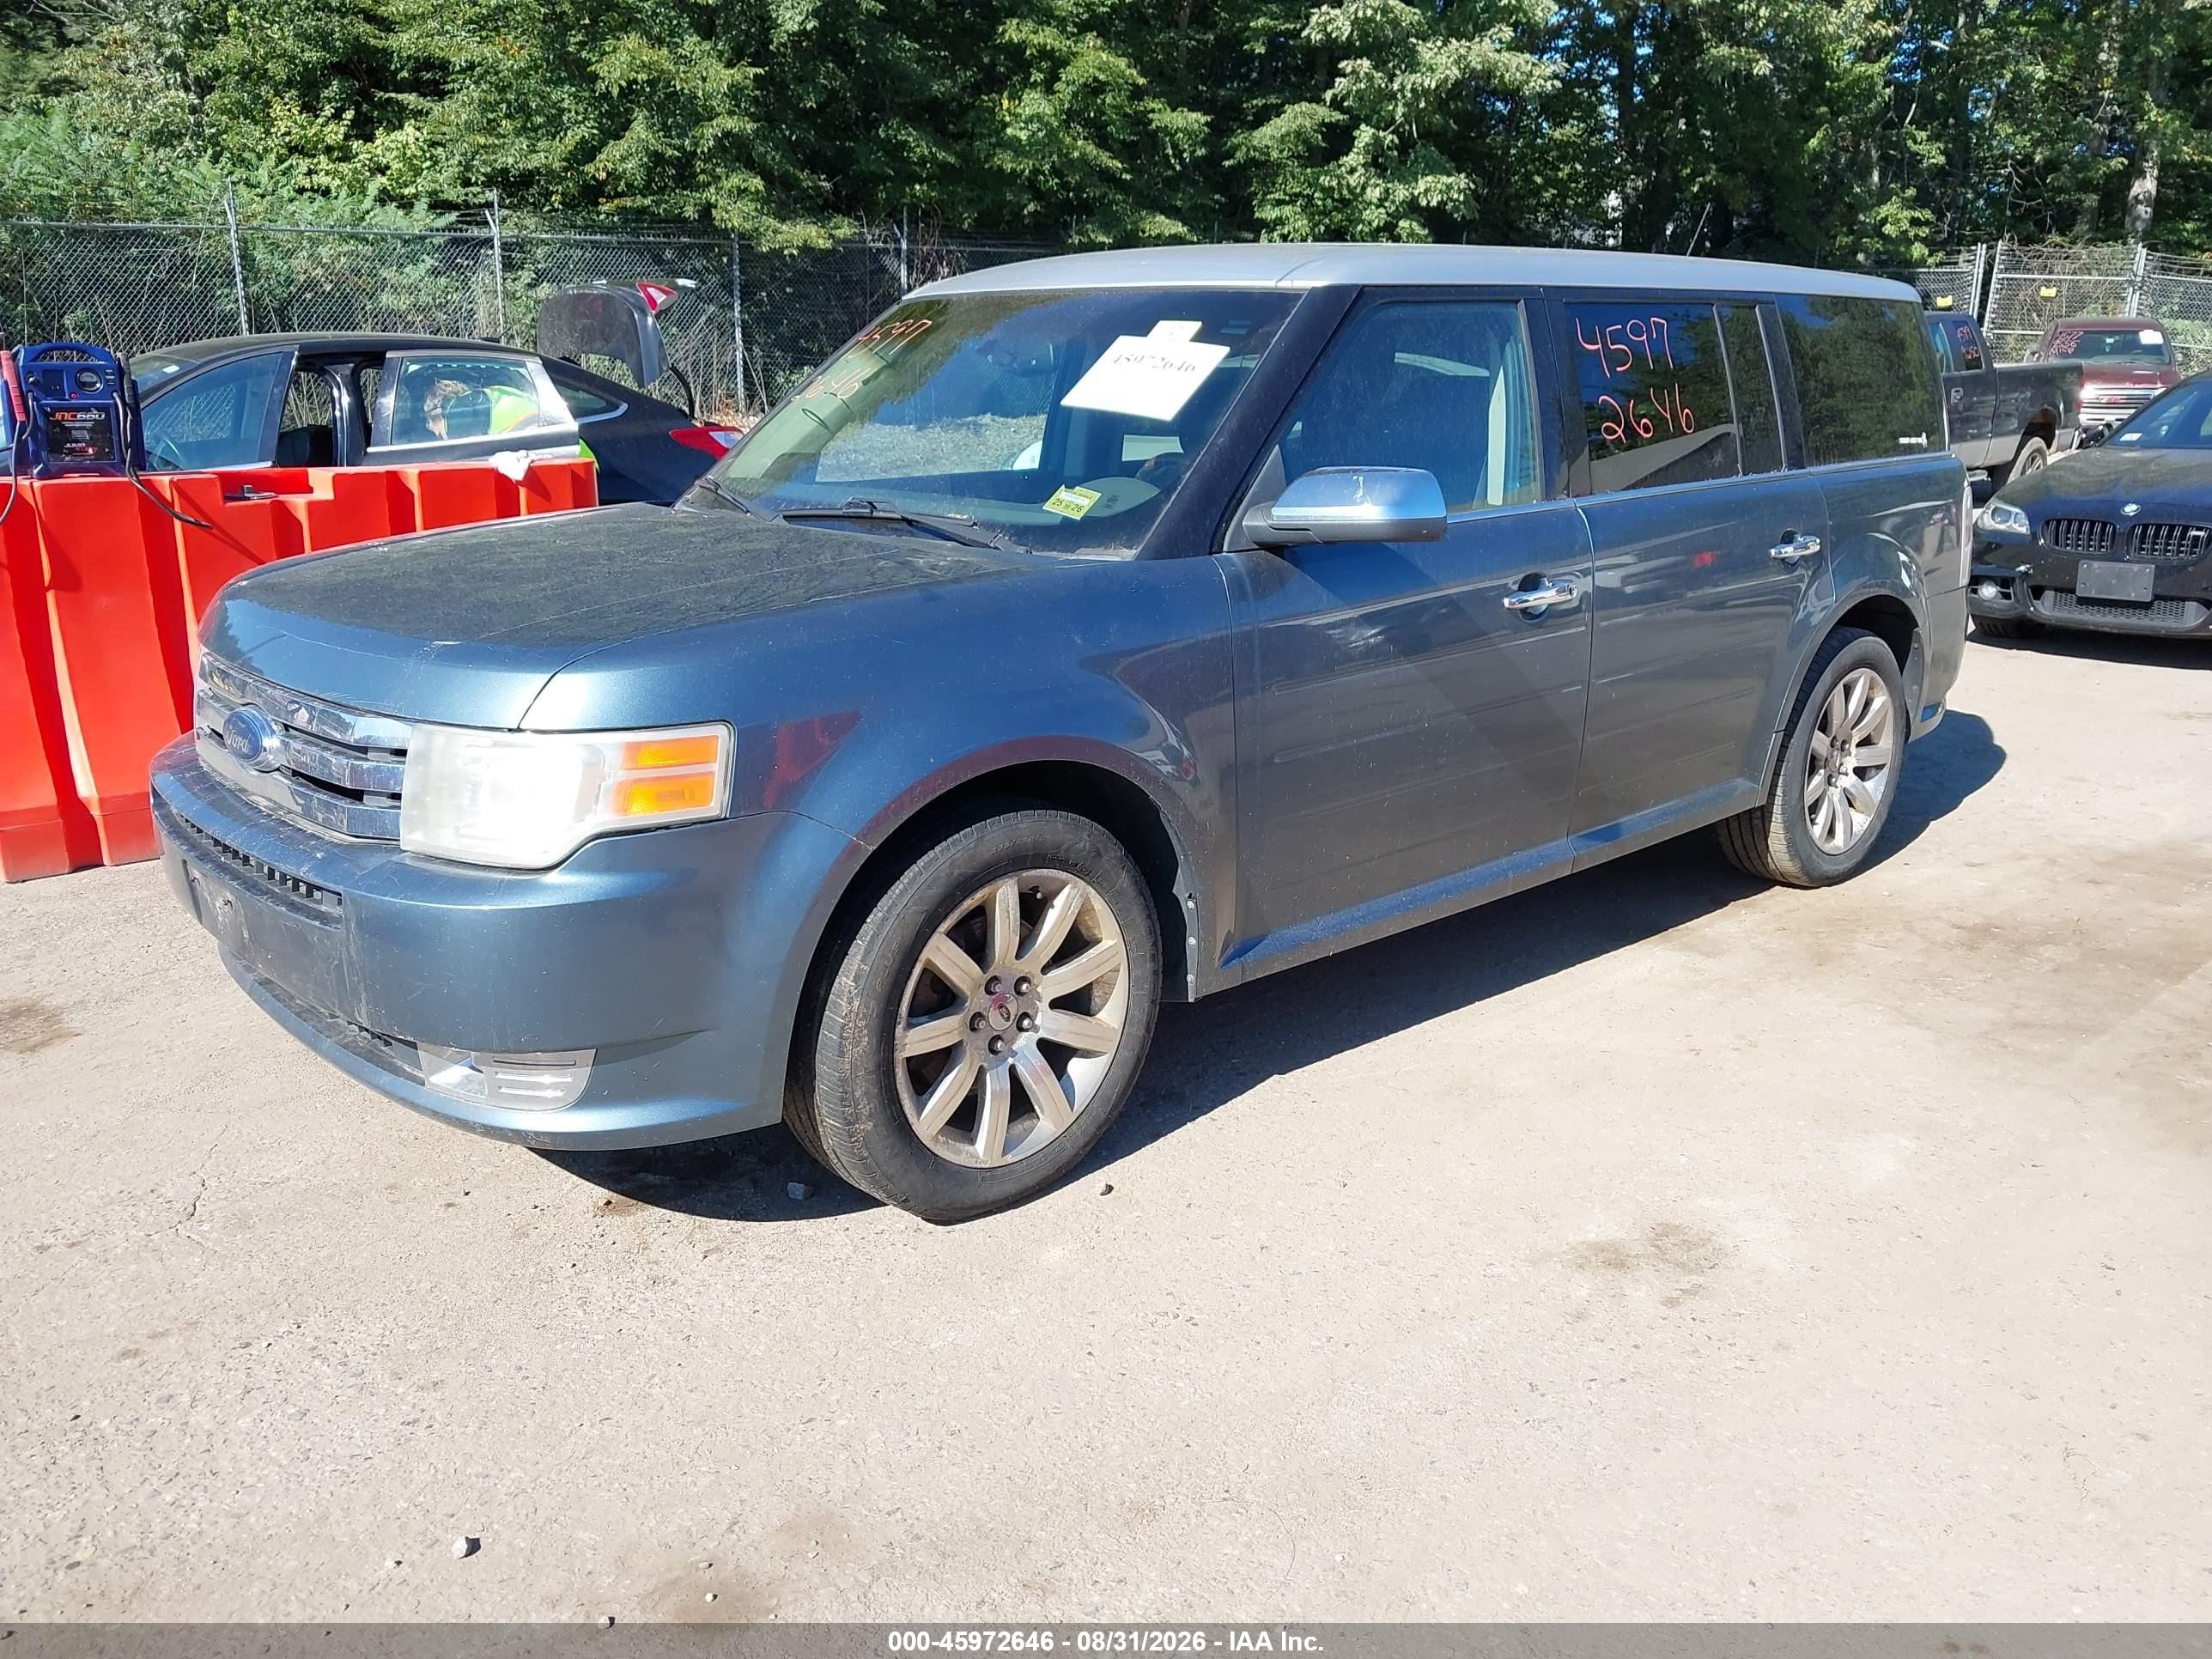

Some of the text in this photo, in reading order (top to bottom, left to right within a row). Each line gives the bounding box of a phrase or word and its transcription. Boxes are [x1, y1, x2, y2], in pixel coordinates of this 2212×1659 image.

[1575, 317, 1674, 379] 4597
[1598, 382, 1695, 444] 2646
[1052, 498, 1065, 507] 25
[1071, 503, 1085, 514] 26
[227, 730, 251, 753] Ford
